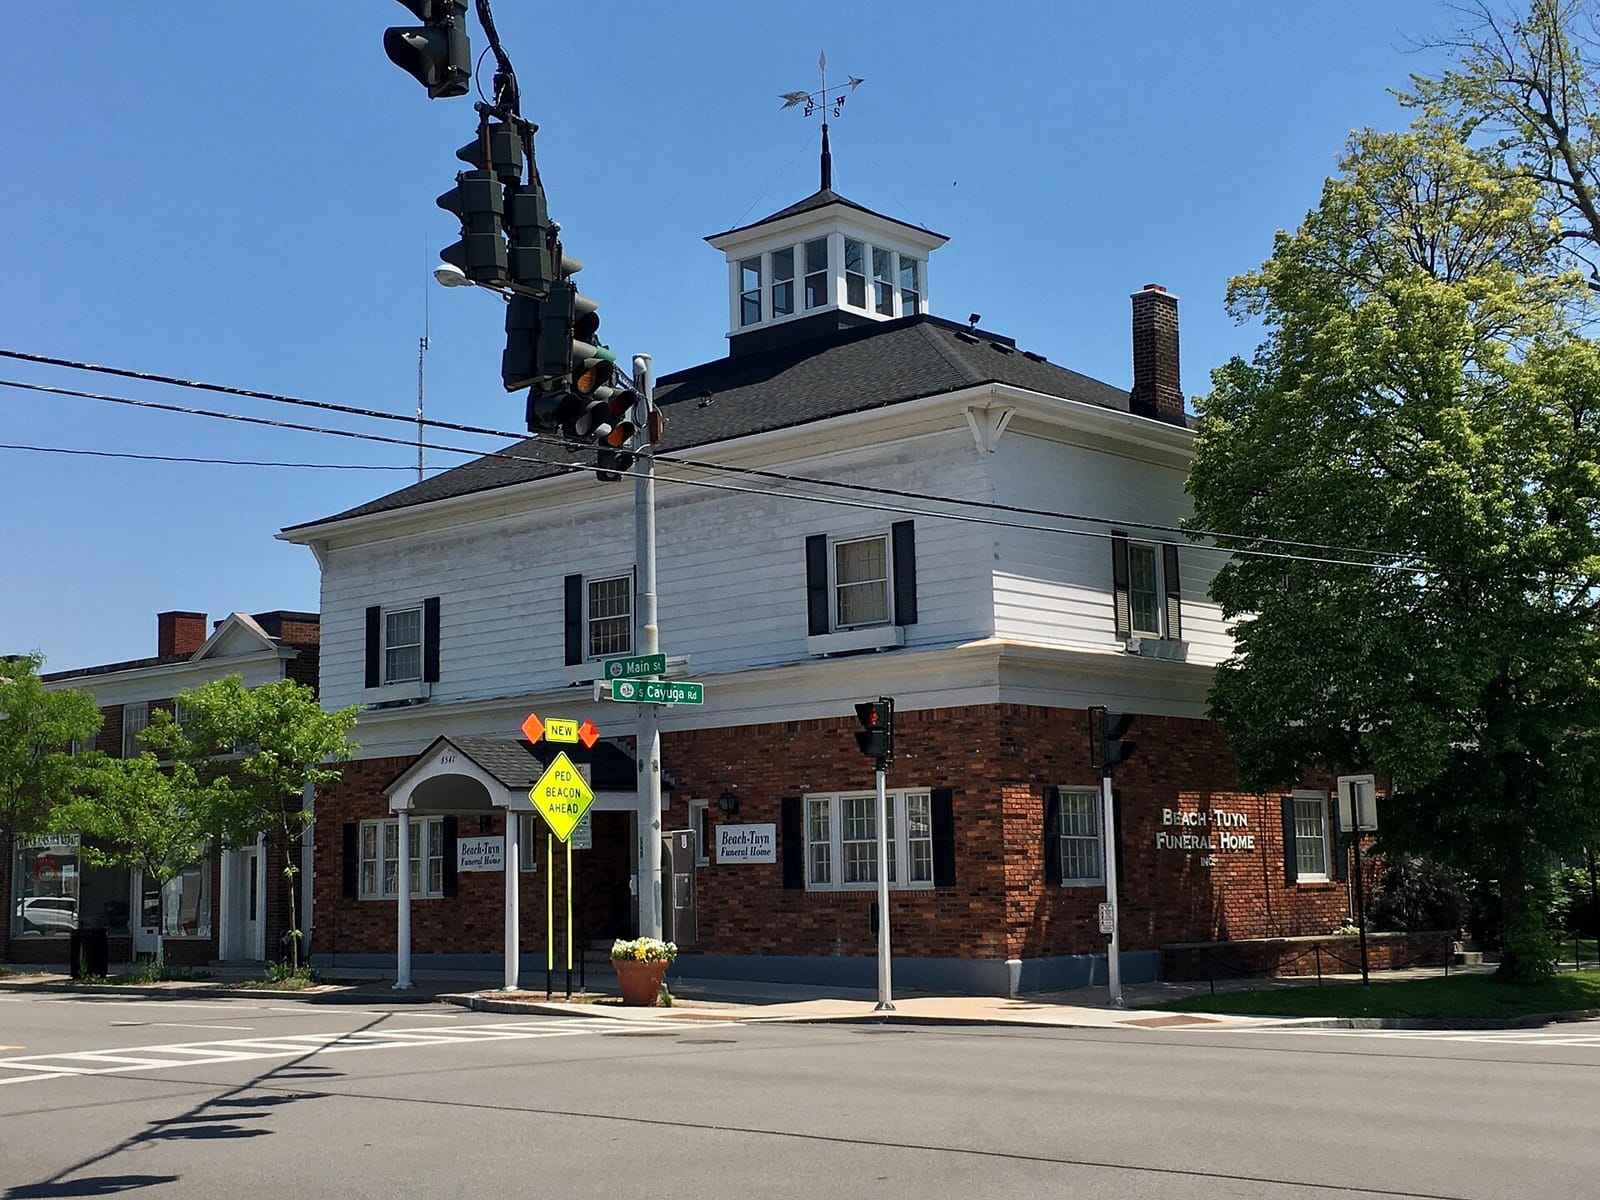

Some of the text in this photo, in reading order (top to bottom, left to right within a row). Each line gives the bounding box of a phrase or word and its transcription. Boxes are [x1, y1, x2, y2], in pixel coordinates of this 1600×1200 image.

[804, 107, 840, 118] E S
[626, 661, 650, 674] Main
[647, 685, 685, 702] Cayuga
[687, 691, 697, 700] Rd
[551, 725, 572, 736] NEW
[555, 770, 572, 781] PED
[545, 786, 581, 799] BEACON
[548, 803, 579, 814] AHEAD
[1156, 832, 1255, 849] FUNERAL HOME
[721, 846, 772, 857] Funeral Home
[461, 856, 501, 867] Funeral Home
